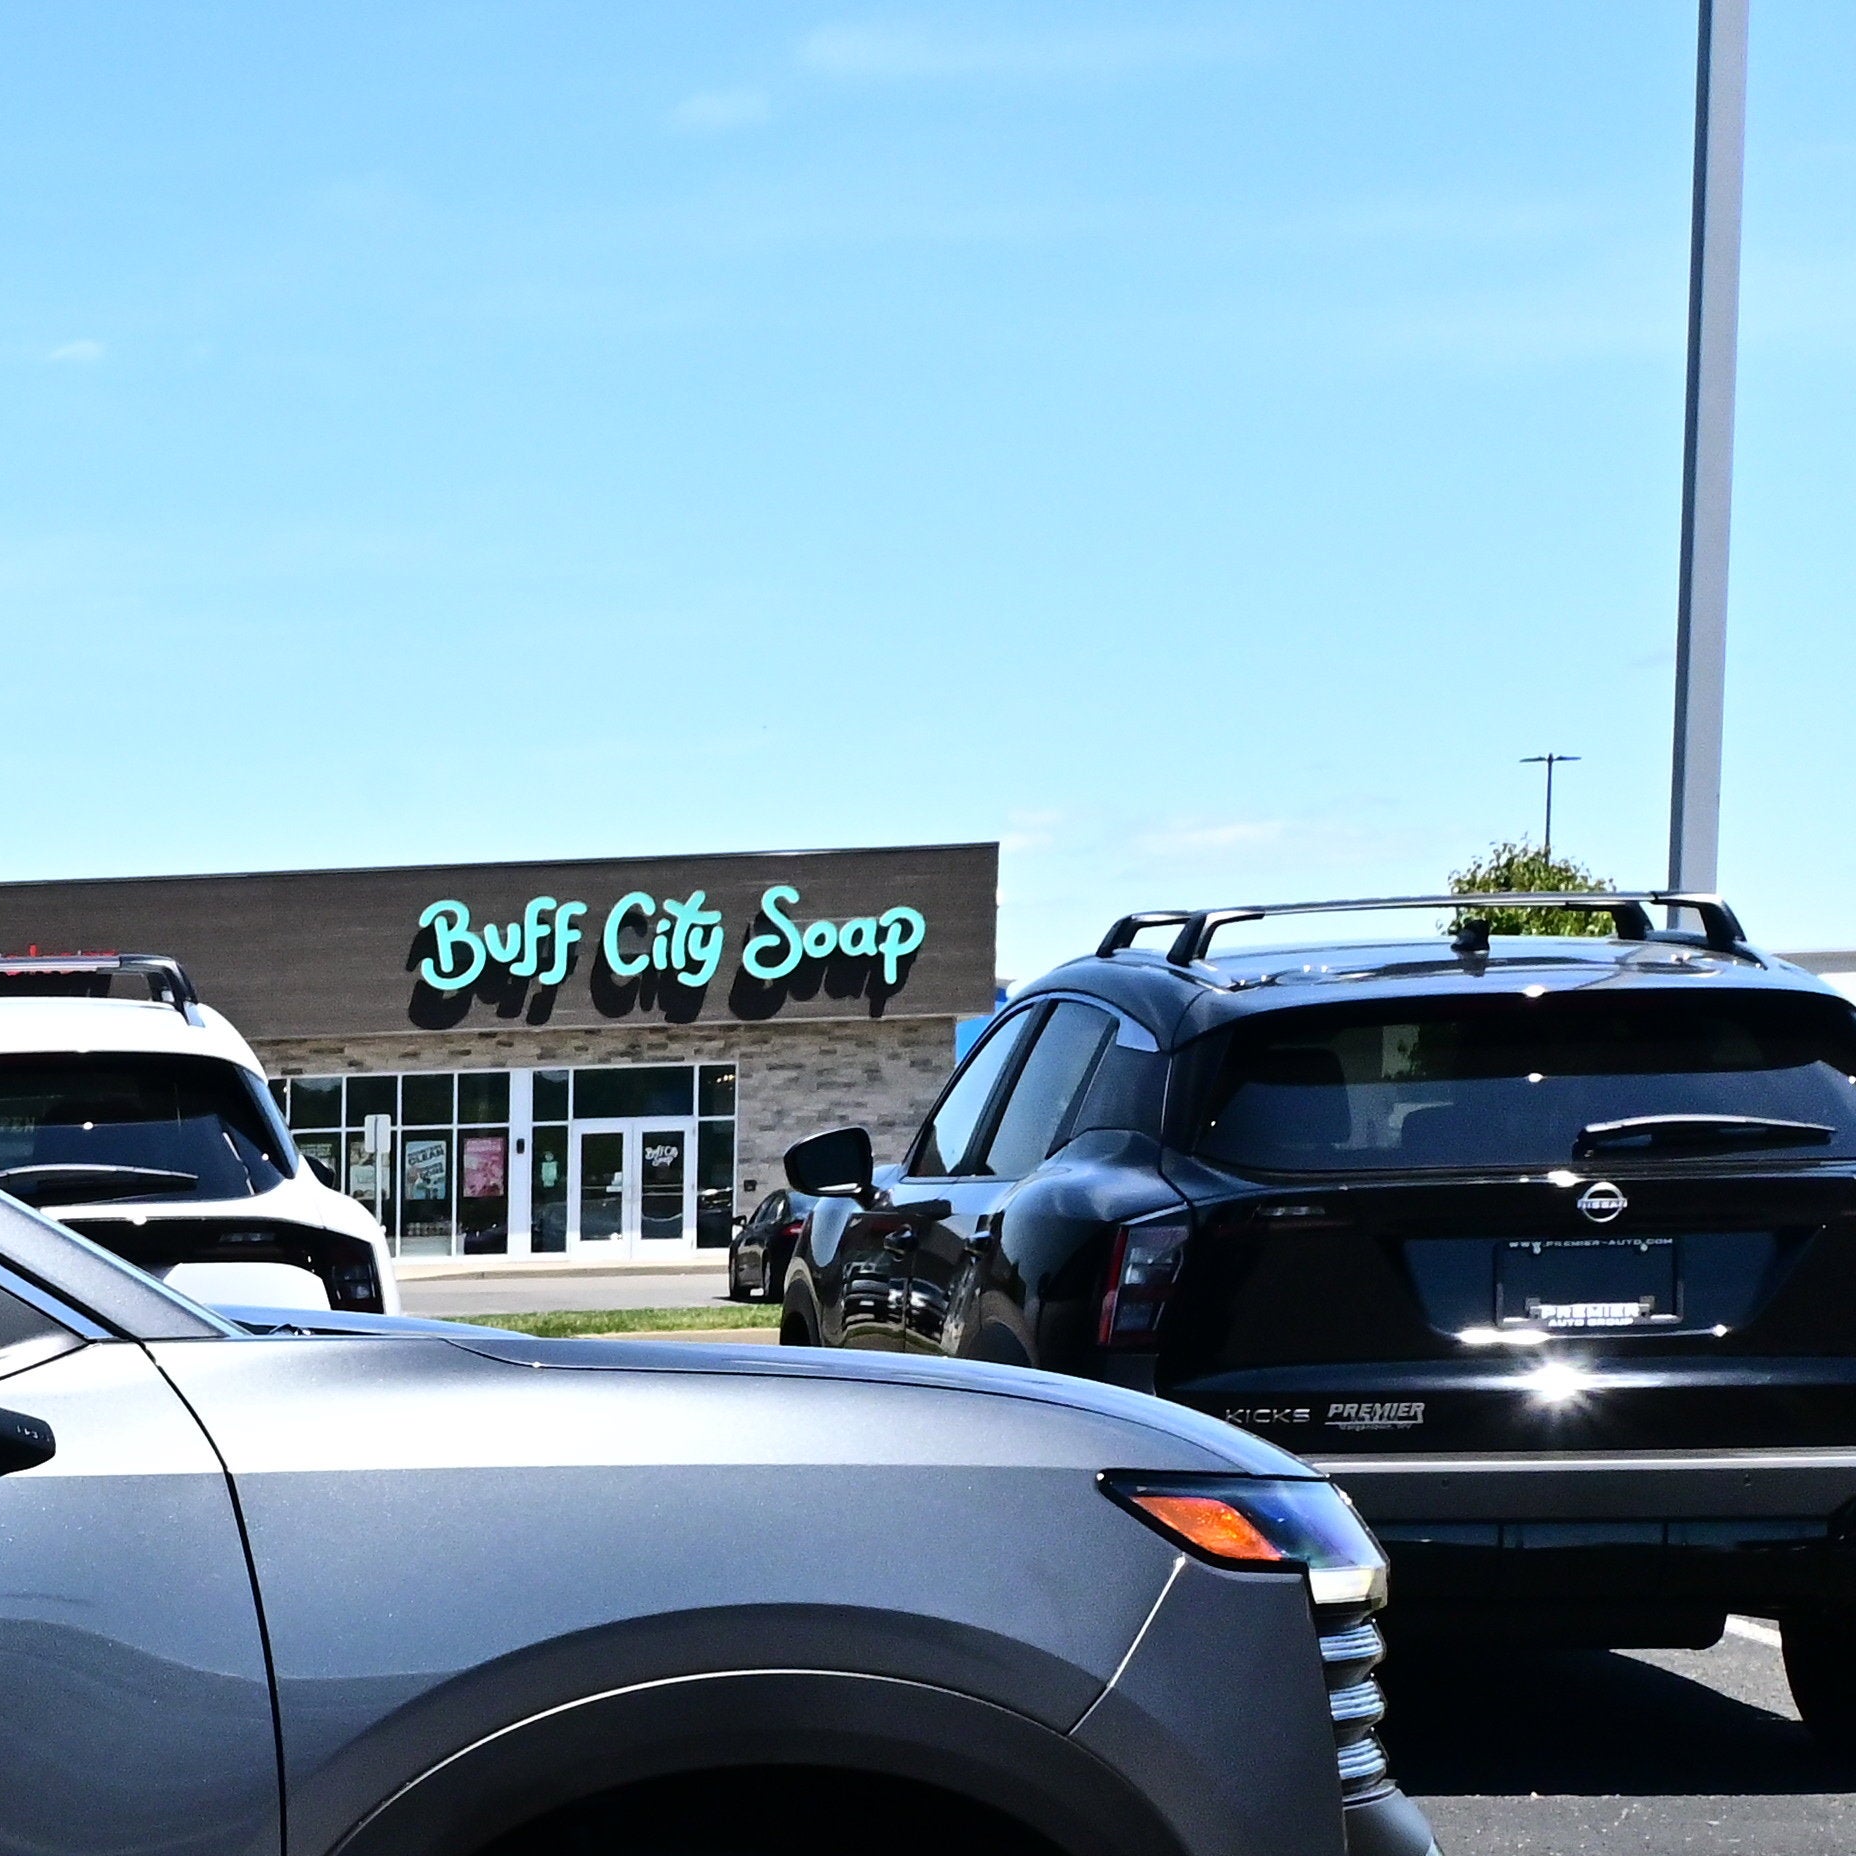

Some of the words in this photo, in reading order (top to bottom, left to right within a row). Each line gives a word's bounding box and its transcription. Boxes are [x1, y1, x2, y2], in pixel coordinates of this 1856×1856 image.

[418, 895, 587, 991] Buff
[603, 889, 724, 987] City
[742, 885, 926, 985] Soap
[1577, 1198, 1628, 1209] NISSAN
[1540, 1303, 1640, 1319] PREMIER
[1548, 1318, 1585, 1327] AUTO
[1587, 1317, 1634, 1326] GROUP
[1224, 1408, 1311, 1424] KICKS
[1327, 1402, 1425, 1422] PREMIER
